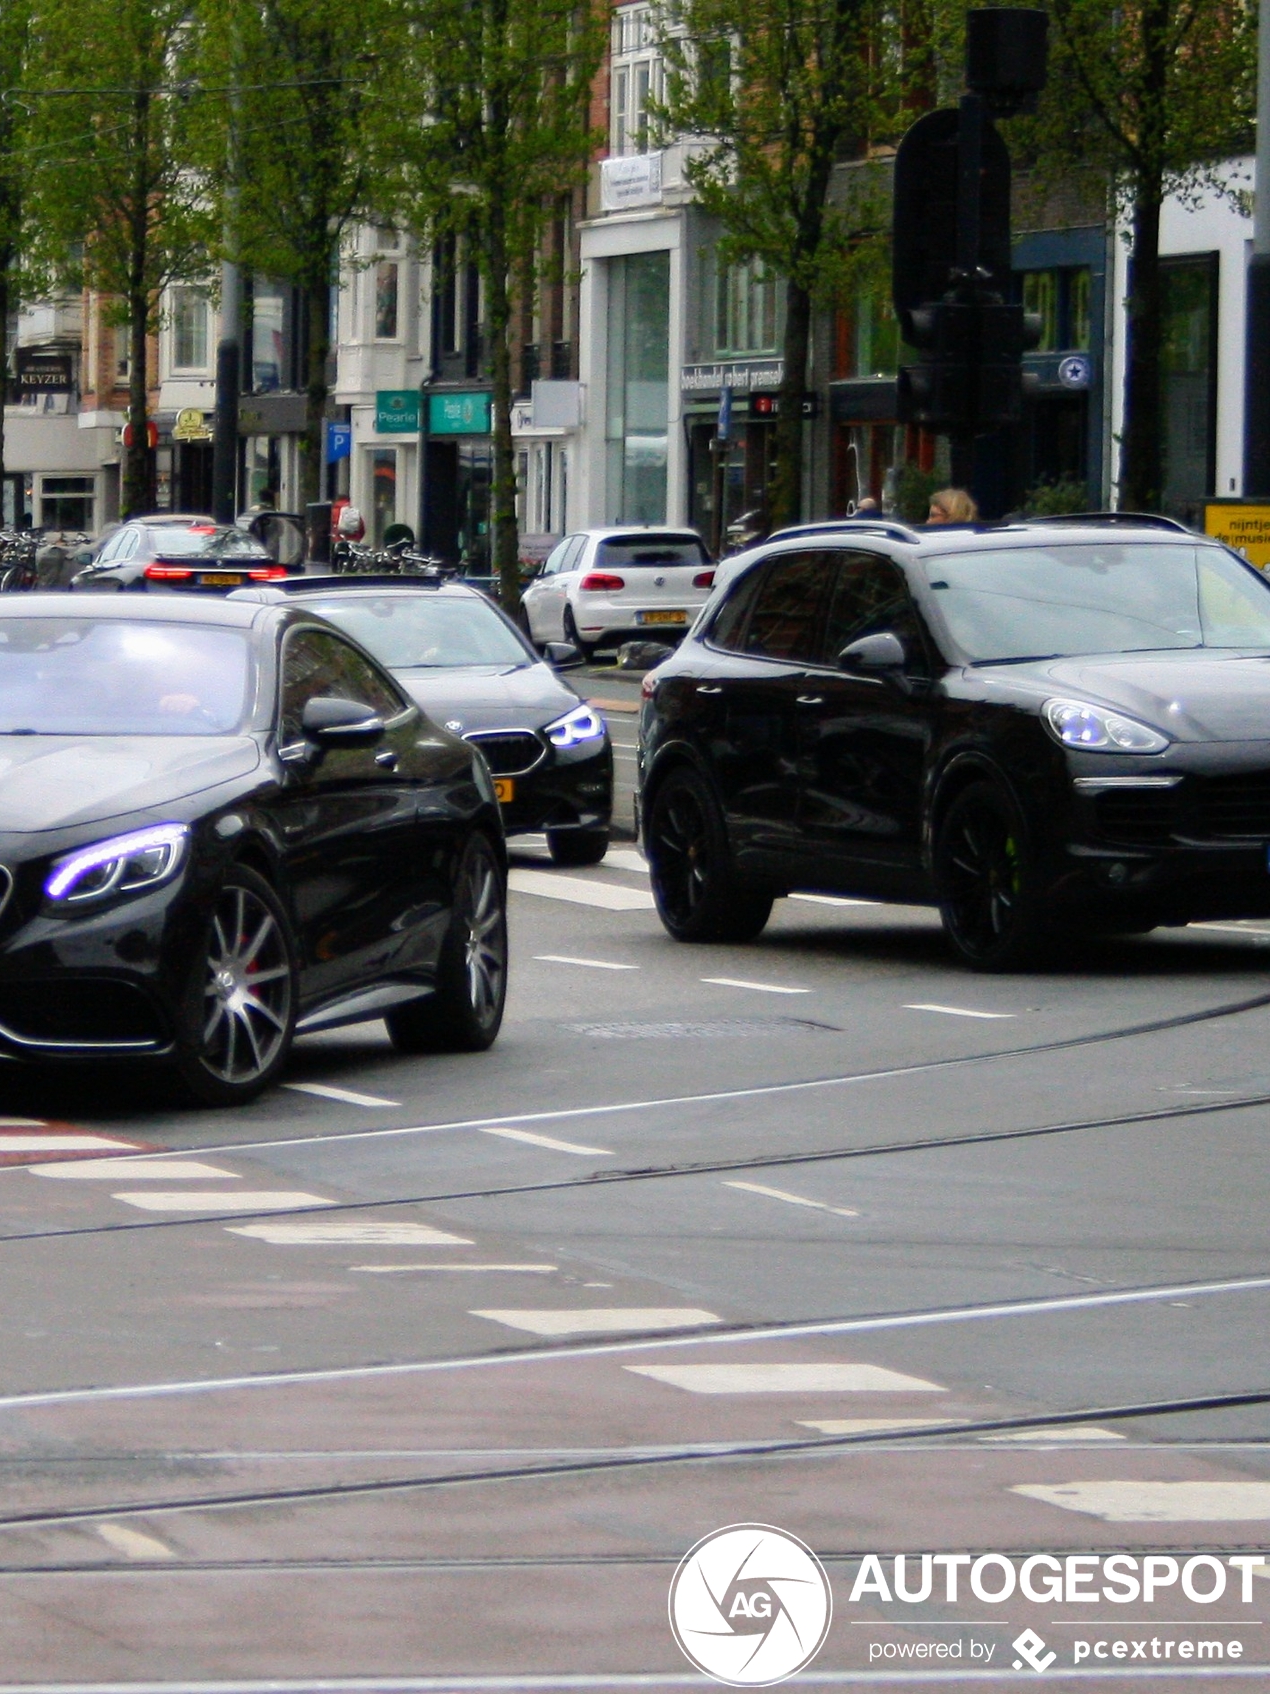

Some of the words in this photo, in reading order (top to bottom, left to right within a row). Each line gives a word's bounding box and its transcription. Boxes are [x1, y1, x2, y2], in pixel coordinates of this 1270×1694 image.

[20, 374, 67, 384] KEYZER
[378, 410, 417, 423] Pearle
[334, 434, 344, 451] P
[1229, 518, 1270, 532] nijntje
